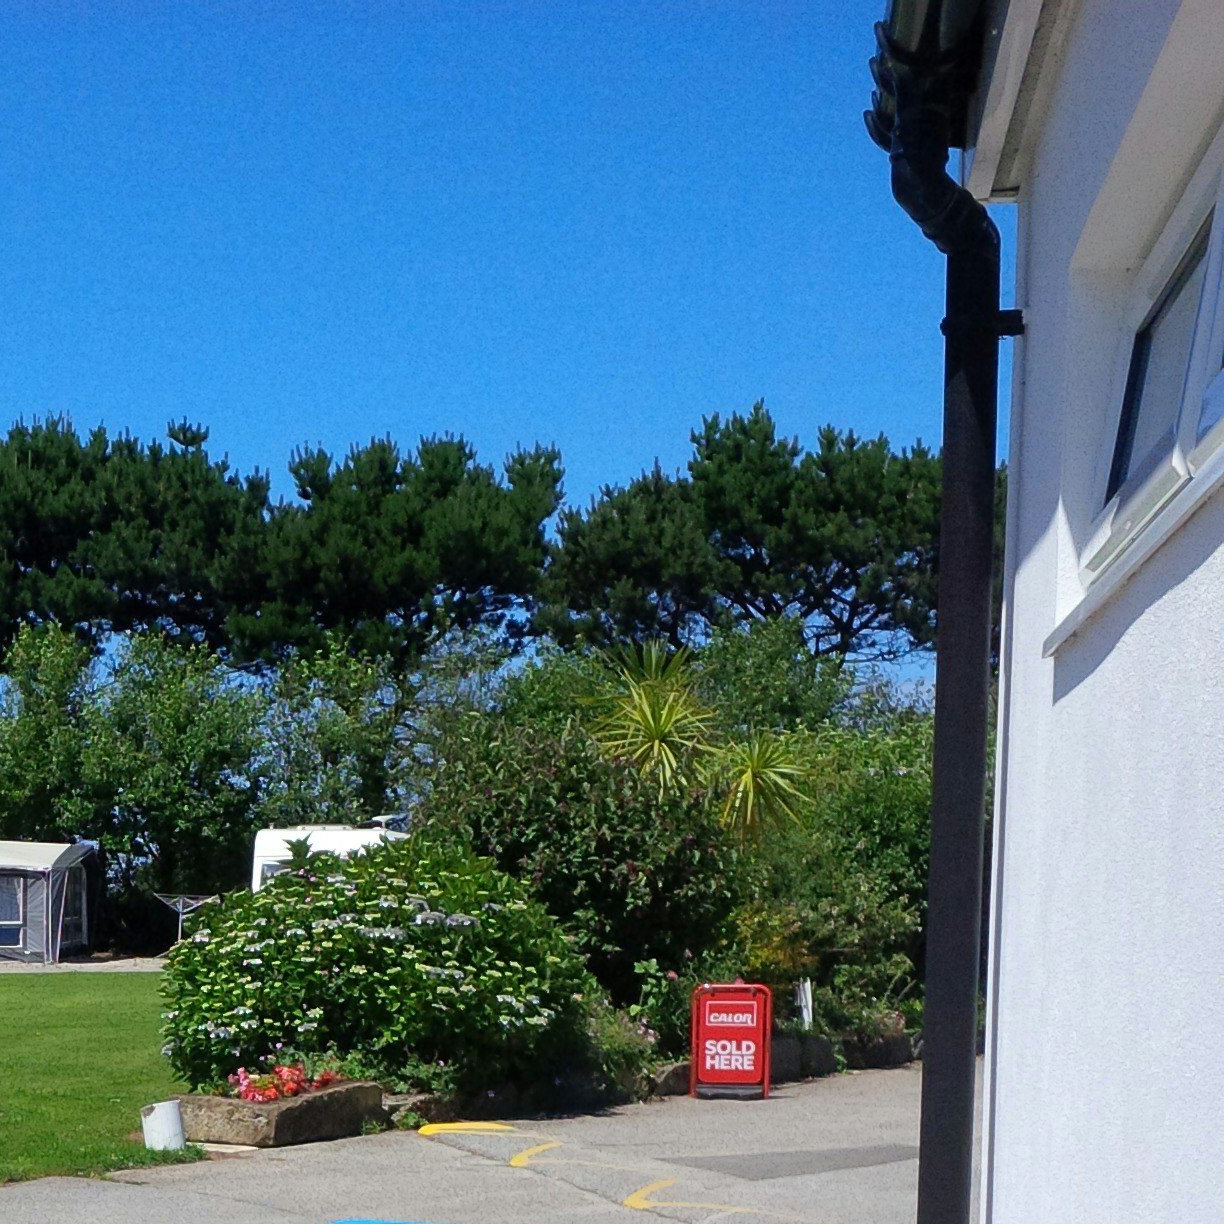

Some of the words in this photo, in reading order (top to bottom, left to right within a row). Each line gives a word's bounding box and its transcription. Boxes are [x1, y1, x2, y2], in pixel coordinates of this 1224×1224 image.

[710, 1012, 752, 1024] CALOR
[705, 1040, 755, 1055] SOLD
[706, 1055, 754, 1070] HERE
